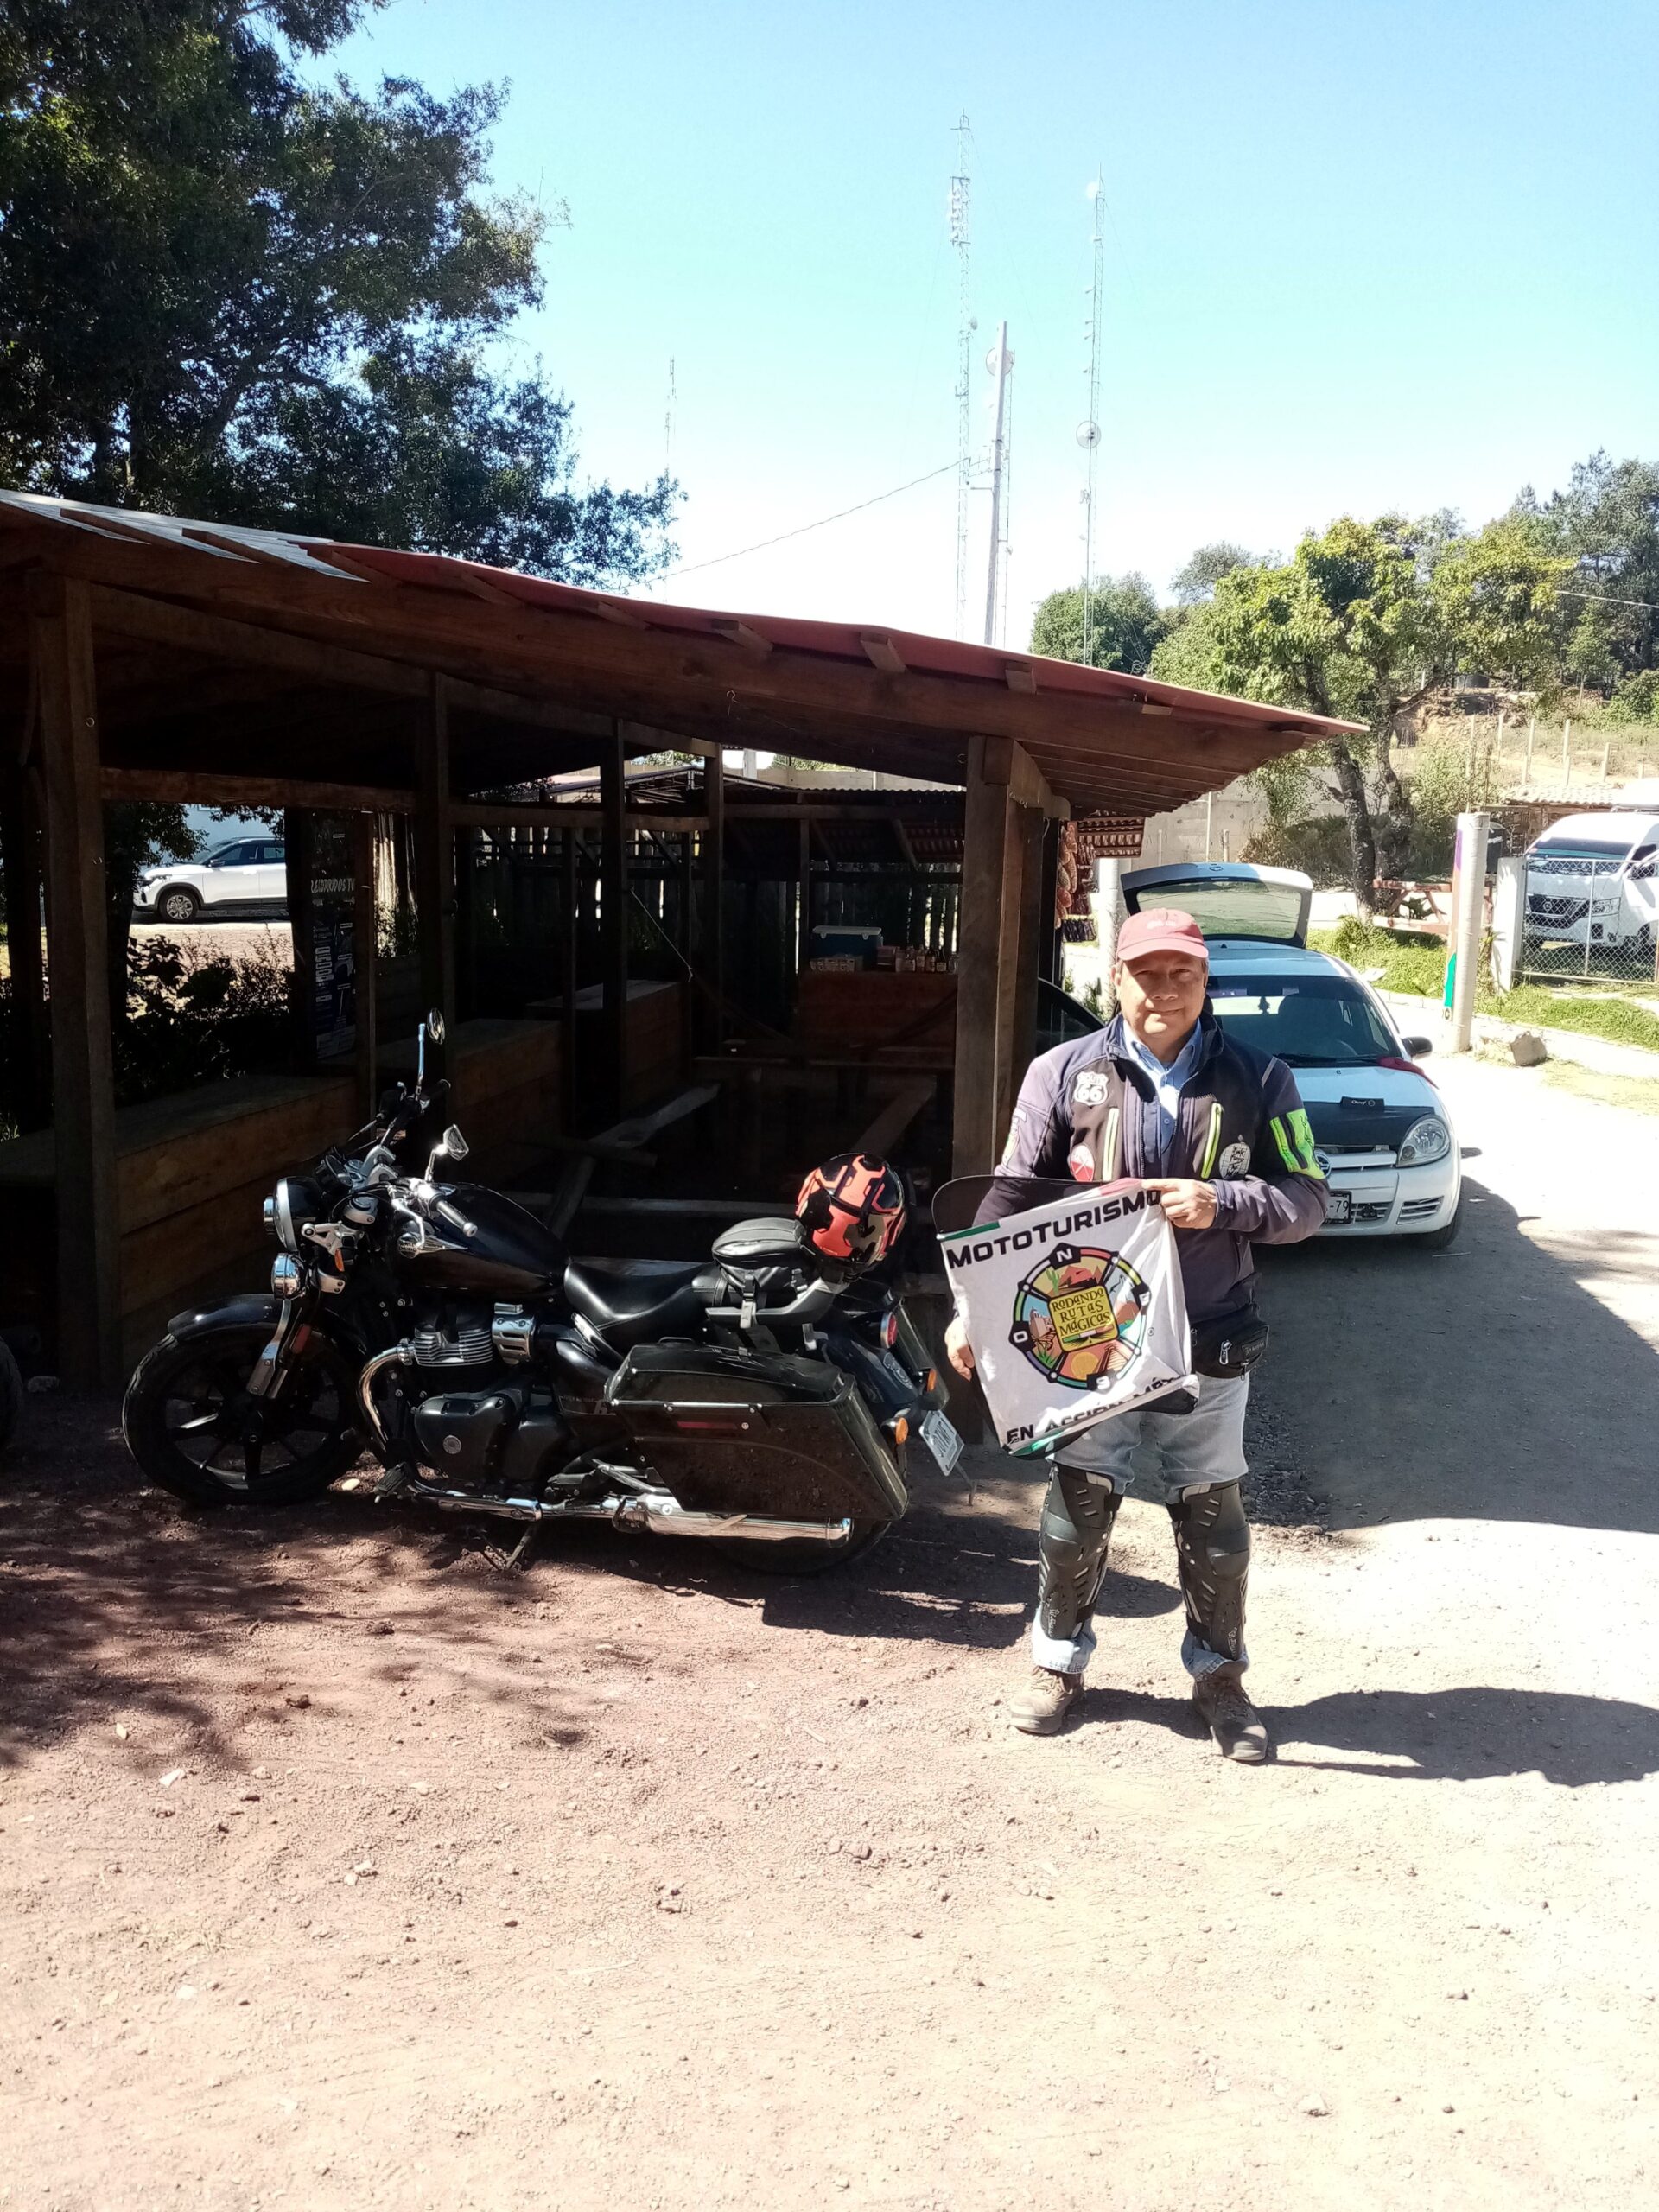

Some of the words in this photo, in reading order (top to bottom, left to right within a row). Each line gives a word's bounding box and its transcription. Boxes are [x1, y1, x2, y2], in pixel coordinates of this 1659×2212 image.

[1077, 1083, 1103, 1103] 66
[946, 1190, 1161, 1269] MOTOTURISMO
[1056, 1248, 1073, 1262] N
[1006, 1424, 1034, 1444] EN
